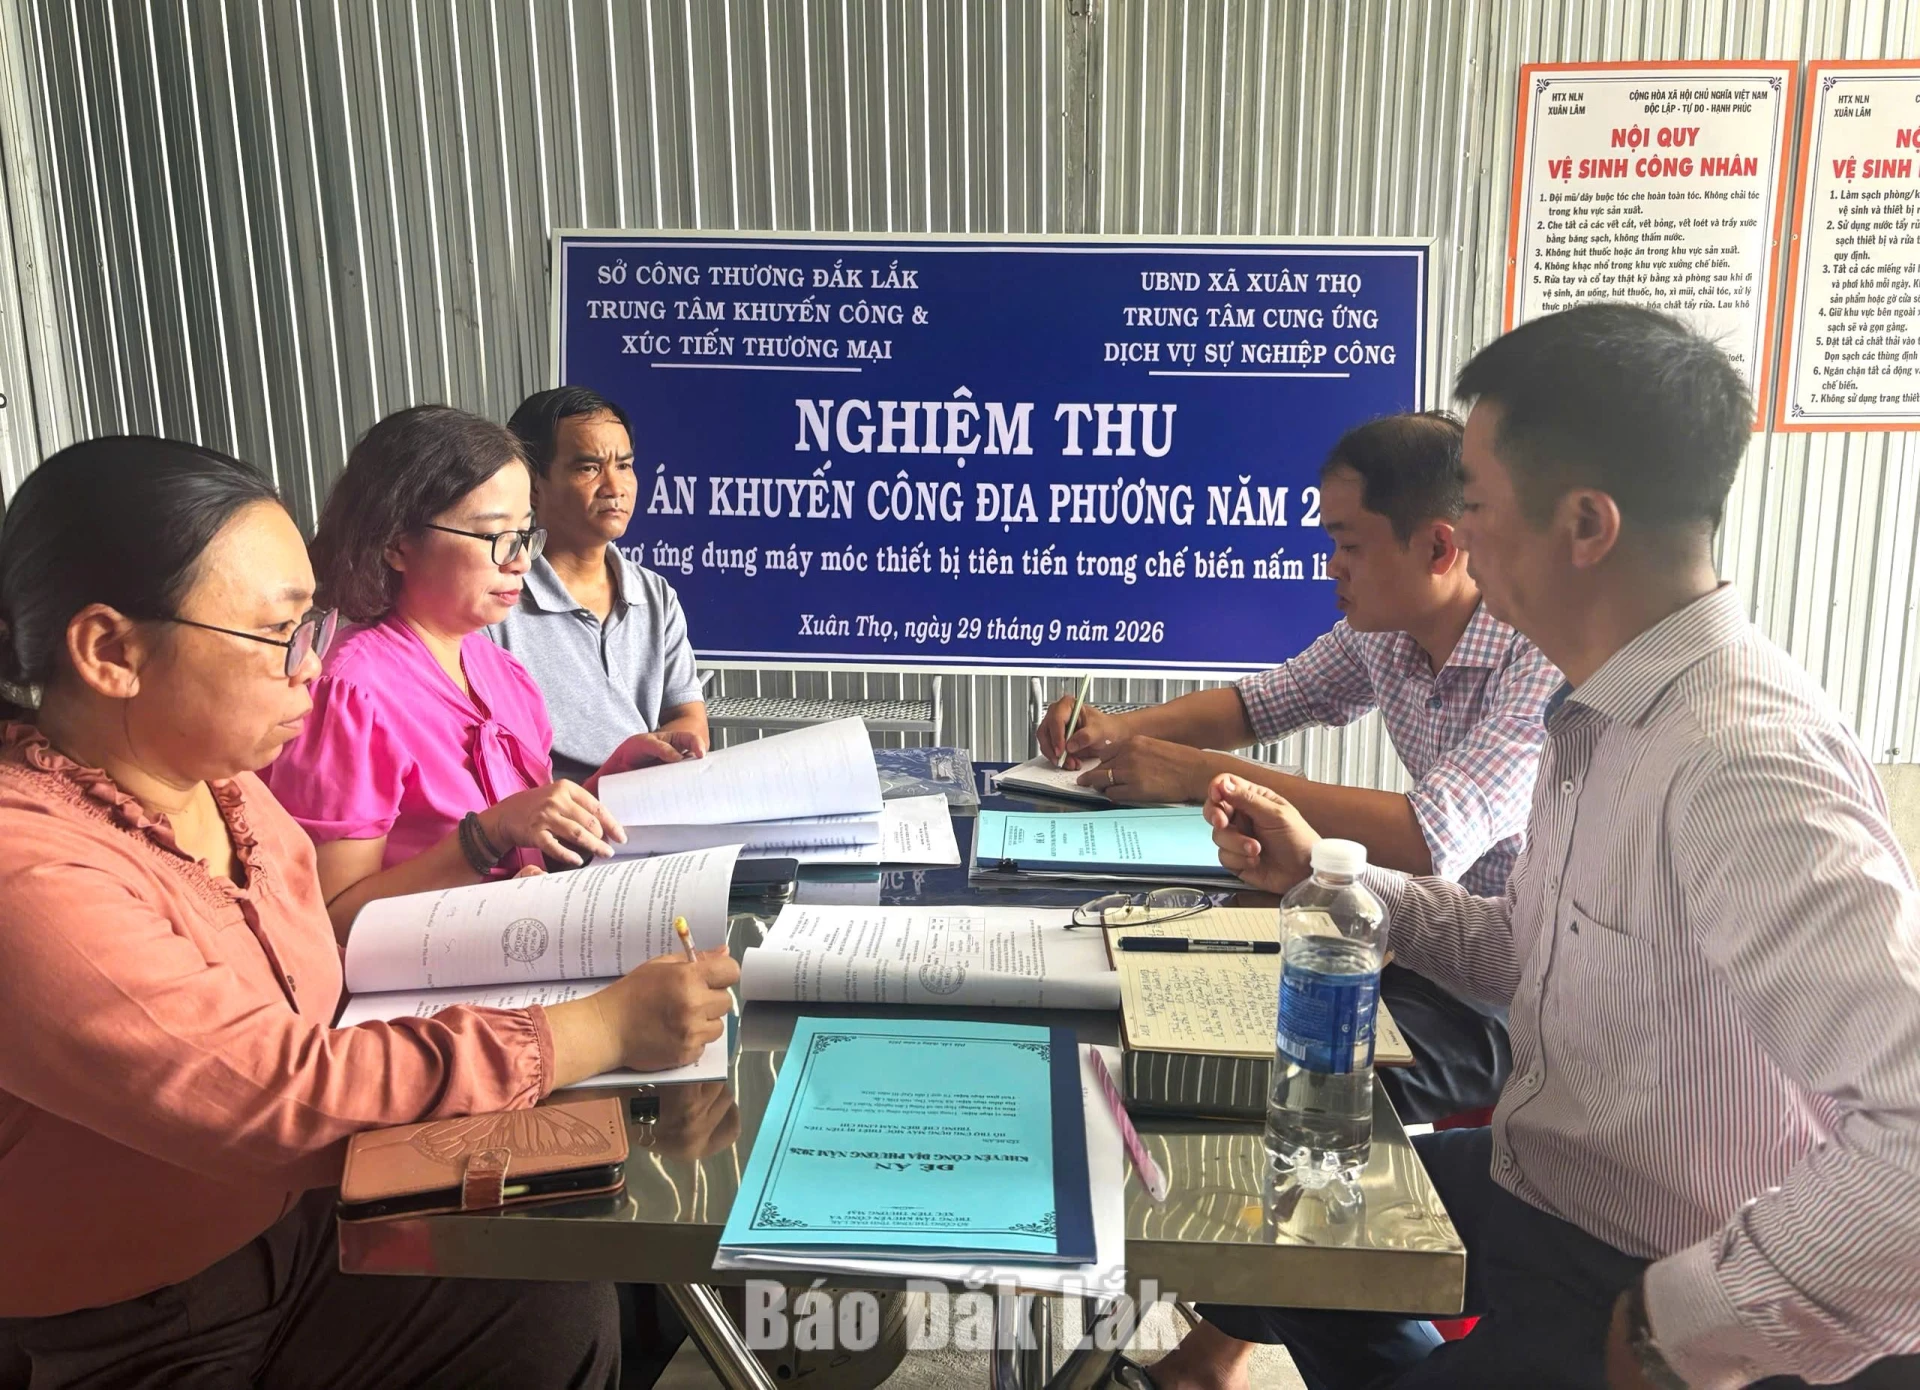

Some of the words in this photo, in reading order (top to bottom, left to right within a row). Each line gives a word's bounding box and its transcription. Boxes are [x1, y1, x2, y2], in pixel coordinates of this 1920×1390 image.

[1552, 93, 1567, 101] HTX
[1568, 92, 1584, 101] NLN
[1629, 89, 1649, 101] CỘNG
[1651, 89, 1666, 100] HÒA
[1668, 89, 1677, 100] XÃ
[1679, 88, 1692, 101] HỘI
[1694, 88, 1709, 100] CHỦ
[1711, 89, 1732, 99] NGHĨA
[1734, 89, 1750, 100] VIỆT
[1752, 91, 1768, 100] NAM
[1838, 95, 1853, 104] HTX
[1854, 95, 1870, 104] NLN
[1548, 104, 1568, 115] XUÂN
[1569, 104, 1586, 115] LÂM
[1644, 102, 1660, 115] ĐỘC
[1661, 104, 1676, 115] LẬP
[1682, 103, 1693, 114] TỰ
[1694, 104, 1704, 113] DO
[1711, 104, 1731, 114] HẠNH
[1732, 104, 1752, 113] PHÚC
[1834, 106, 1854, 117] XUÂN
[1855, 106, 1871, 117] LÂM
[1611, 123, 1651, 153] NỘI
[1657, 126, 1701, 149] QUY
[1547, 155, 1573, 184] VỆ
[1577, 158, 1629, 179] SINH
[1635, 154, 1695, 178] CÔNG
[1700, 154, 1759, 178] NHÂN
[1832, 155, 1857, 184] VỆ
[1862, 158, 1913, 179] SINH
[1546, 233, 1566, 244] bằng
[1568, 234, 1588, 244] băng
[1590, 233, 1612, 244] sạch,
[1614, 233, 1639, 243] không
[1641, 232, 1661, 242] thấm
[1664, 233, 1685, 241] nước.
[1535, 248, 1543, 257] 3.
[1545, 248, 1571, 258] Không
[1573, 248, 1587, 256] hút
[1589, 246, 1611, 256] thuốc
[1614, 247, 1633, 257] hoặc
[1635, 247, 1645, 255] ăn
[1647, 247, 1669, 256] trong
[1671, 246, 1687, 255] khu
[1689, 247, 1702, 256] vực
[1705, 245, 1718, 254] sản
[1721, 245, 1740, 254] xuất.
[1834, 253, 1848, 261] quy
[1850, 250, 1870, 262] định.
[1534, 262, 1542, 270] 4.
[1544, 262, 1570, 271] Không
[1572, 261, 1592, 271] khạc
[1594, 259, 1610, 270] nhổ
[1611, 261, 1633, 270] trong
[1635, 260, 1651, 269] khu
[1653, 261, 1667, 270] vực
[1669, 259, 1692, 269] xưởng
[1695, 259, 1711, 268] chế
[1711, 258, 1730, 268] biến.
[598, 259, 627, 284] SỞ
[636, 261, 700, 285] CÔNG
[708, 264, 804, 287] THƯƠNG
[813, 259, 863, 288] ĐẮK
[871, 260, 919, 289] LẮK
[1141, 272, 1200, 291] UBND
[1208, 268, 1240, 292] XÃ
[1246, 268, 1309, 292] XUÂN
[1316, 274, 1361, 298] THỌ
[587, 300, 666, 319] TRUNG
[674, 296, 725, 320] TÂM
[733, 295, 831, 322] KHUYẾN
[839, 300, 904, 324] CÔNG
[912, 306, 928, 324] &
[1123, 307, 1199, 327] TRUNG
[1206, 303, 1255, 327] TÂM
[1263, 309, 1324, 328] CUNG
[1332, 304, 1379, 329] ỨNG
[1827, 322, 1845, 333] sạch
[1848, 322, 1857, 332] sẽ
[1859, 322, 1868, 331] và
[1869, 324, 1884, 333] gọn
[1886, 322, 1908, 333] gàng.
[622, 330, 670, 354] XÚC
[679, 328, 734, 355] TIẾN
[742, 335, 839, 358] THƯƠNG
[847, 340, 892, 363] MẠI
[1816, 336, 1824, 346] 5.
[1826, 337, 1839, 347] Đặt
[1842, 336, 1853, 346] tất
[1855, 335, 1864, 346] cả
[1866, 335, 1883, 345] chất
[1885, 335, 1900, 345] thải
[1902, 336, 1916, 345] vào
[1104, 343, 1160, 366] DỊCH
[1166, 343, 1196, 367] VỤ
[1205, 341, 1234, 367] SỰ
[1241, 339, 1327, 368] NGHIỆP
[1334, 340, 1396, 364] CÔNG
[1824, 351, 1840, 362] Dọn
[1842, 351, 1860, 362] sạch
[1862, 351, 1875, 360] các
[1877, 351, 1900, 362] thùng
[1902, 351, 1918, 361] định
[1822, 380, 1838, 390] chế
[1838, 380, 1858, 390] biến.
[795, 385, 1034, 470] NGHIỆM
[1054, 403, 1177, 457] THU
[647, 463, 697, 514] ÁN
[709, 460, 855, 519] KHUYẾN
[868, 470, 964, 522] CÔNG
[975, 483, 1038, 532] ĐỊA
[1049, 477, 1195, 525] PHƯƠNG
[1206, 475, 1289, 526] NĂM
[1302, 486, 1322, 527] 2
[652, 540, 694, 575] ứng
[702, 541, 758, 577] dụng
[765, 543, 813, 577] máy
[821, 545, 868, 571] móc
[876, 541, 932, 573] thiết
[939, 546, 960, 580] bị
[968, 547, 1014, 574] tiên
[1026, 544, 1068, 576] tiến
[1076, 551, 1138, 585] trong
[1145, 546, 1188, 578] chế
[1194, 546, 1246, 580] biến
[1253, 547, 1304, 580] nấm
[1312, 552, 1336, 581] li
[798, 614, 850, 636] Xuân
[856, 615, 898, 642] Thọ,
[905, 615, 952, 644] ngày
[957, 617, 981, 639] 29
[987, 617, 1044, 646] tháng
[1048, 619, 1061, 641] 9
[1066, 620, 1109, 641] năm
[1114, 620, 1164, 643] 2026
[789, 1147, 816, 1156] 2026
[816, 1150, 849, 1159] NĂM
[850, 1151, 906, 1160] PHƯƠNG
[907, 1151, 931, 1160] ĐỊA
[933, 1153, 972, 1162] CÔNG
[874, 1162, 912, 1172] ÁN
[918, 1163, 955, 1173] ĐỀ
